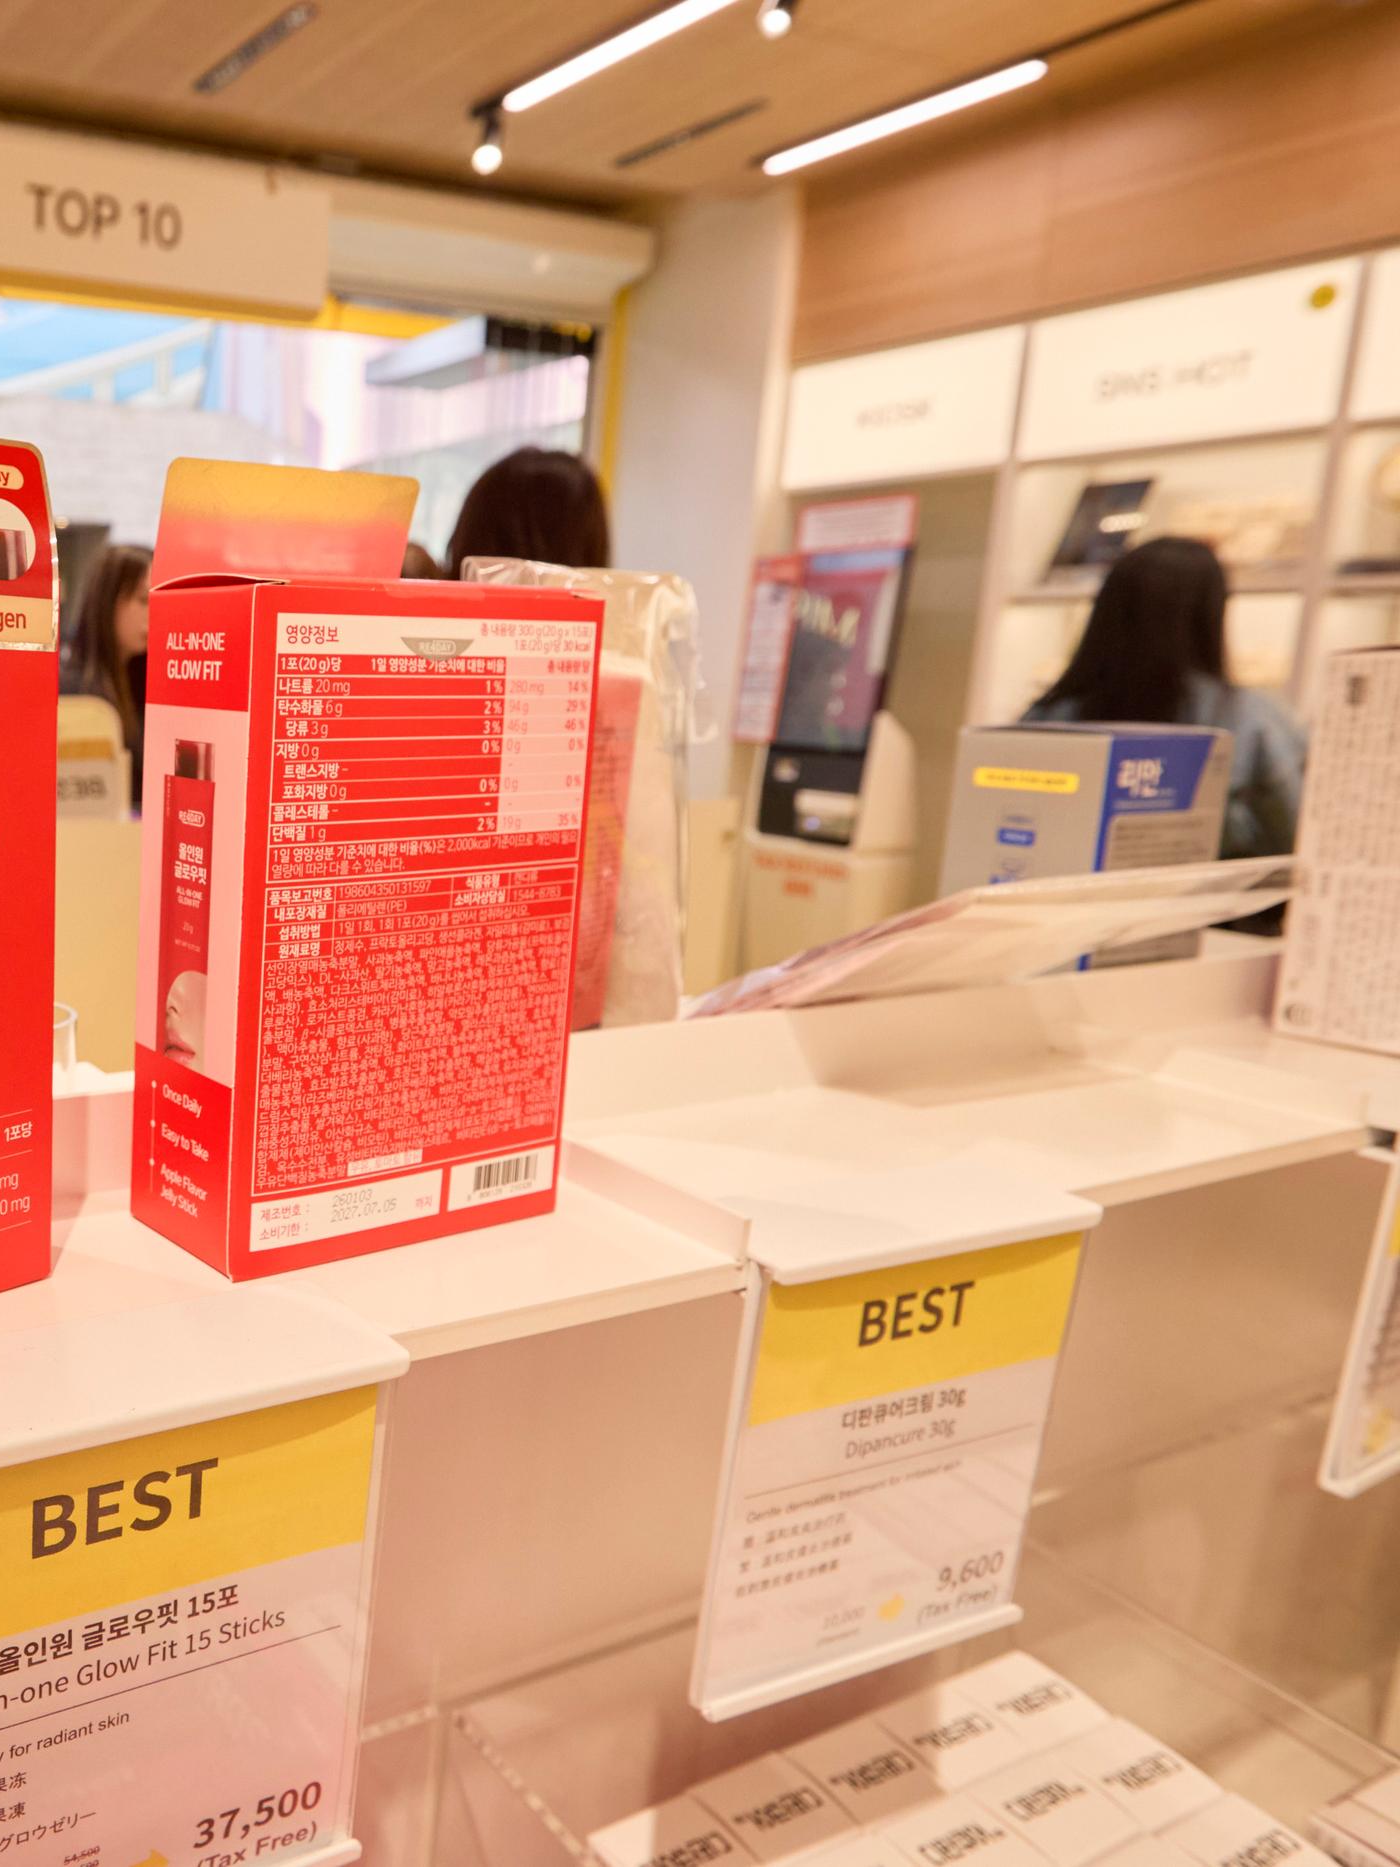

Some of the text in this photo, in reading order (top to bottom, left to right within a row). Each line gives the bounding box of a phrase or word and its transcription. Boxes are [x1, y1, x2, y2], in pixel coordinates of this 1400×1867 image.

[24, 182, 183, 251] TOP 10
[166, 632, 226, 651] ALL-IN-ONE
[286, 625, 340, 644] 영양정보
[167, 659, 222, 681] GLOW FIT
[371, 658, 386, 673] 1일
[389, 658, 427, 673] 영양성분
[467, 659, 486, 673] 대한
[279, 678, 351, 696] 나트륨 20 mg
[278, 700, 323, 716] 탄수화물
[285, 720, 309, 737] 당류
[276, 743, 299, 759] 지방
[283, 763, 340, 780] 트랜스지방
[282, 784, 328, 799] 포화지방
[273, 804, 329, 821] 콜레스테롤
[272, 826, 306, 842] 단백질
[179, 842, 203, 864] 올인원
[273, 849, 290, 863] 1일
[293, 847, 334, 861] 영양성분
[337, 843, 376, 859] 기준치에
[379, 842, 398, 857] 대한
[174, 861, 207, 886] 글로우핏
[272, 857, 406, 879] 열량에 따라 다를 수 있습니다.
[269, 887, 333, 906] 품목보고번호
[273, 903, 327, 922] 내포장재질
[279, 923, 321, 940] 섭취방법
[278, 942, 320, 959] 원재료명
[162, 1084, 202, 1119] Once Daily
[4, 1121, 33, 1142] 1포당
[161, 1123, 209, 1162] Easy to Take
[0, 1173, 19, 1191] mg
[160, 1163, 182, 1187] Apple
[11, 1196, 30, 1213] mg
[160, 1184, 177, 1207] Jelly
[261, 1204, 301, 1222] 제조번호
[259, 1223, 300, 1241] 소비기한
[858, 1281, 975, 1348] BEST
[938, 1388, 966, 1408] 30g
[845, 1420, 956, 1460] Dipancure 30g
[32, 1457, 219, 1560] BEST
[937, 1550, 1004, 1592] 9,600
[81, 1600, 180, 1650] 글로우핏
[187, 1584, 240, 1620] 15포
[77, 1654, 140, 1686] Glow
[147, 1639, 178, 1666] Fit
[185, 1628, 212, 1655] 15
[218, 1608, 286, 1645] Sticks
[9, 1741, 31, 1759] for
[36, 1723, 94, 1752] radiant
[97, 1710, 130, 1732] skin
[193, 1781, 322, 1848] 37,500
[255, 1820, 318, 1857] Free)
